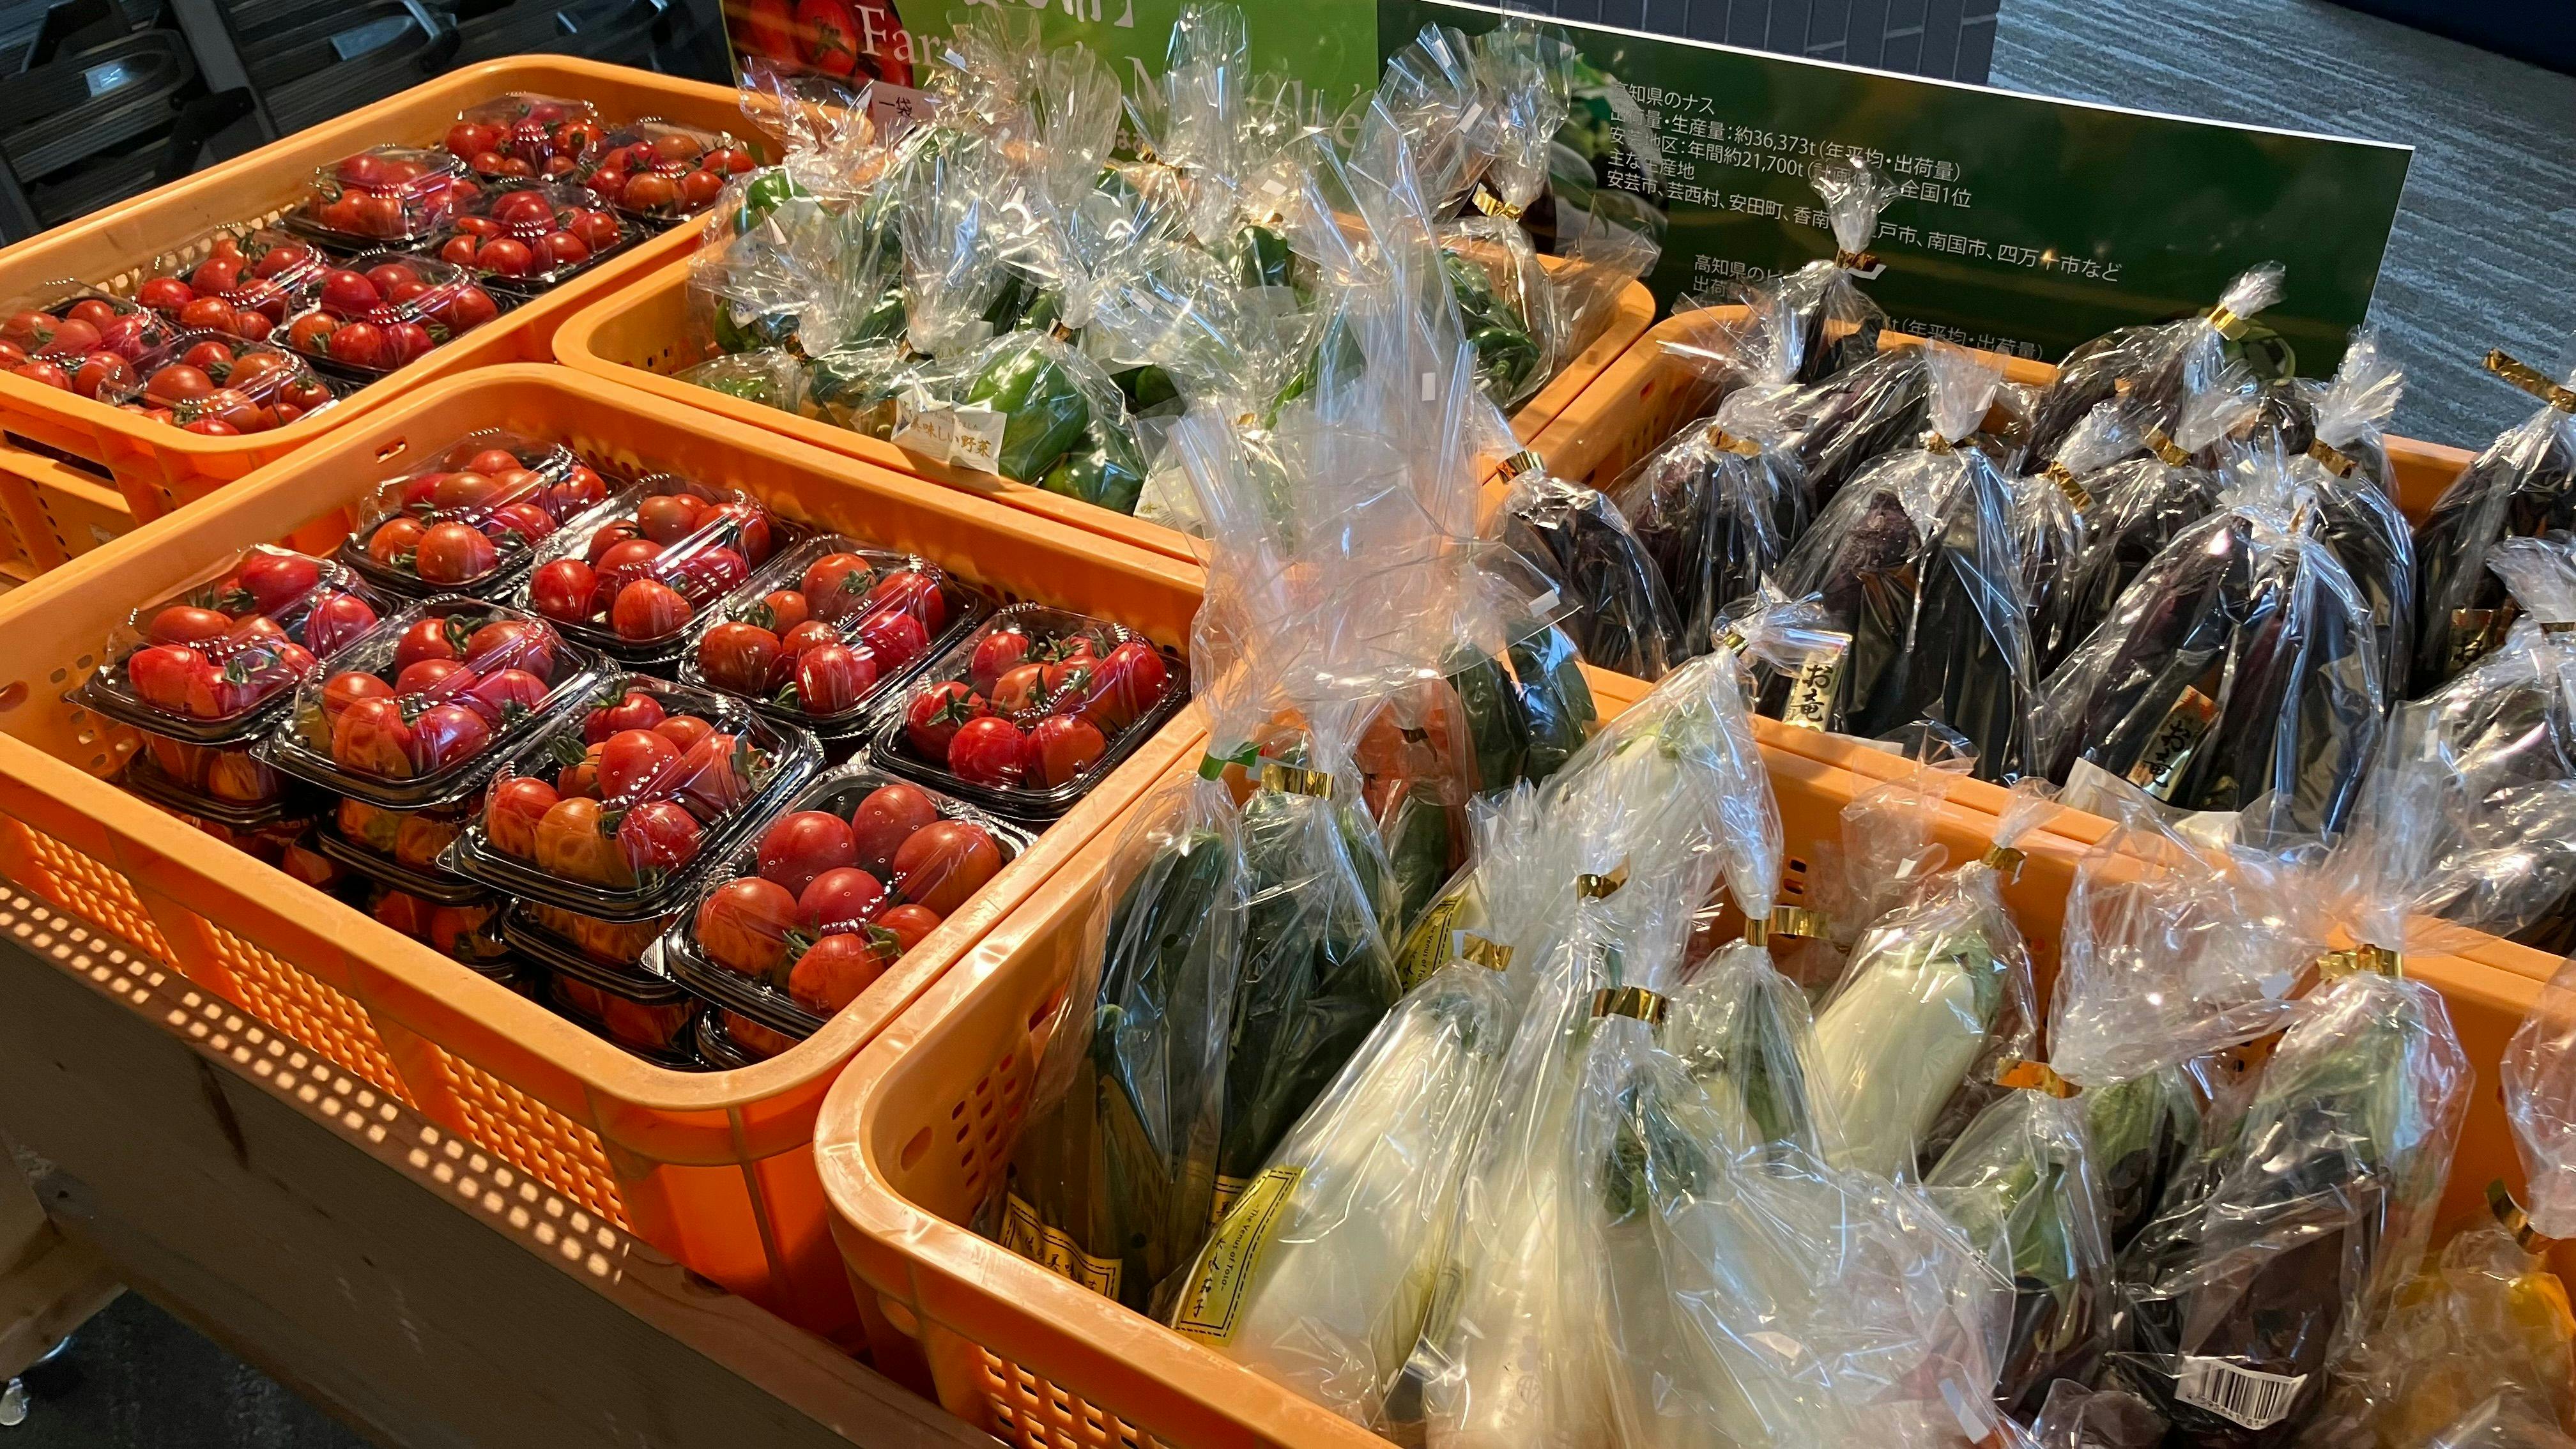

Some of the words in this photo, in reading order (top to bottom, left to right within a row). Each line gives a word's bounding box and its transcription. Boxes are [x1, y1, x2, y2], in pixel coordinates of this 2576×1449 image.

[1614, 82, 1715, 115] 高知県のナス
[1607, 148, 1695, 180] 主な生産地
[1232, 1225, 1250, 1250] Venus
[1229, 1252, 1236, 1263] of
